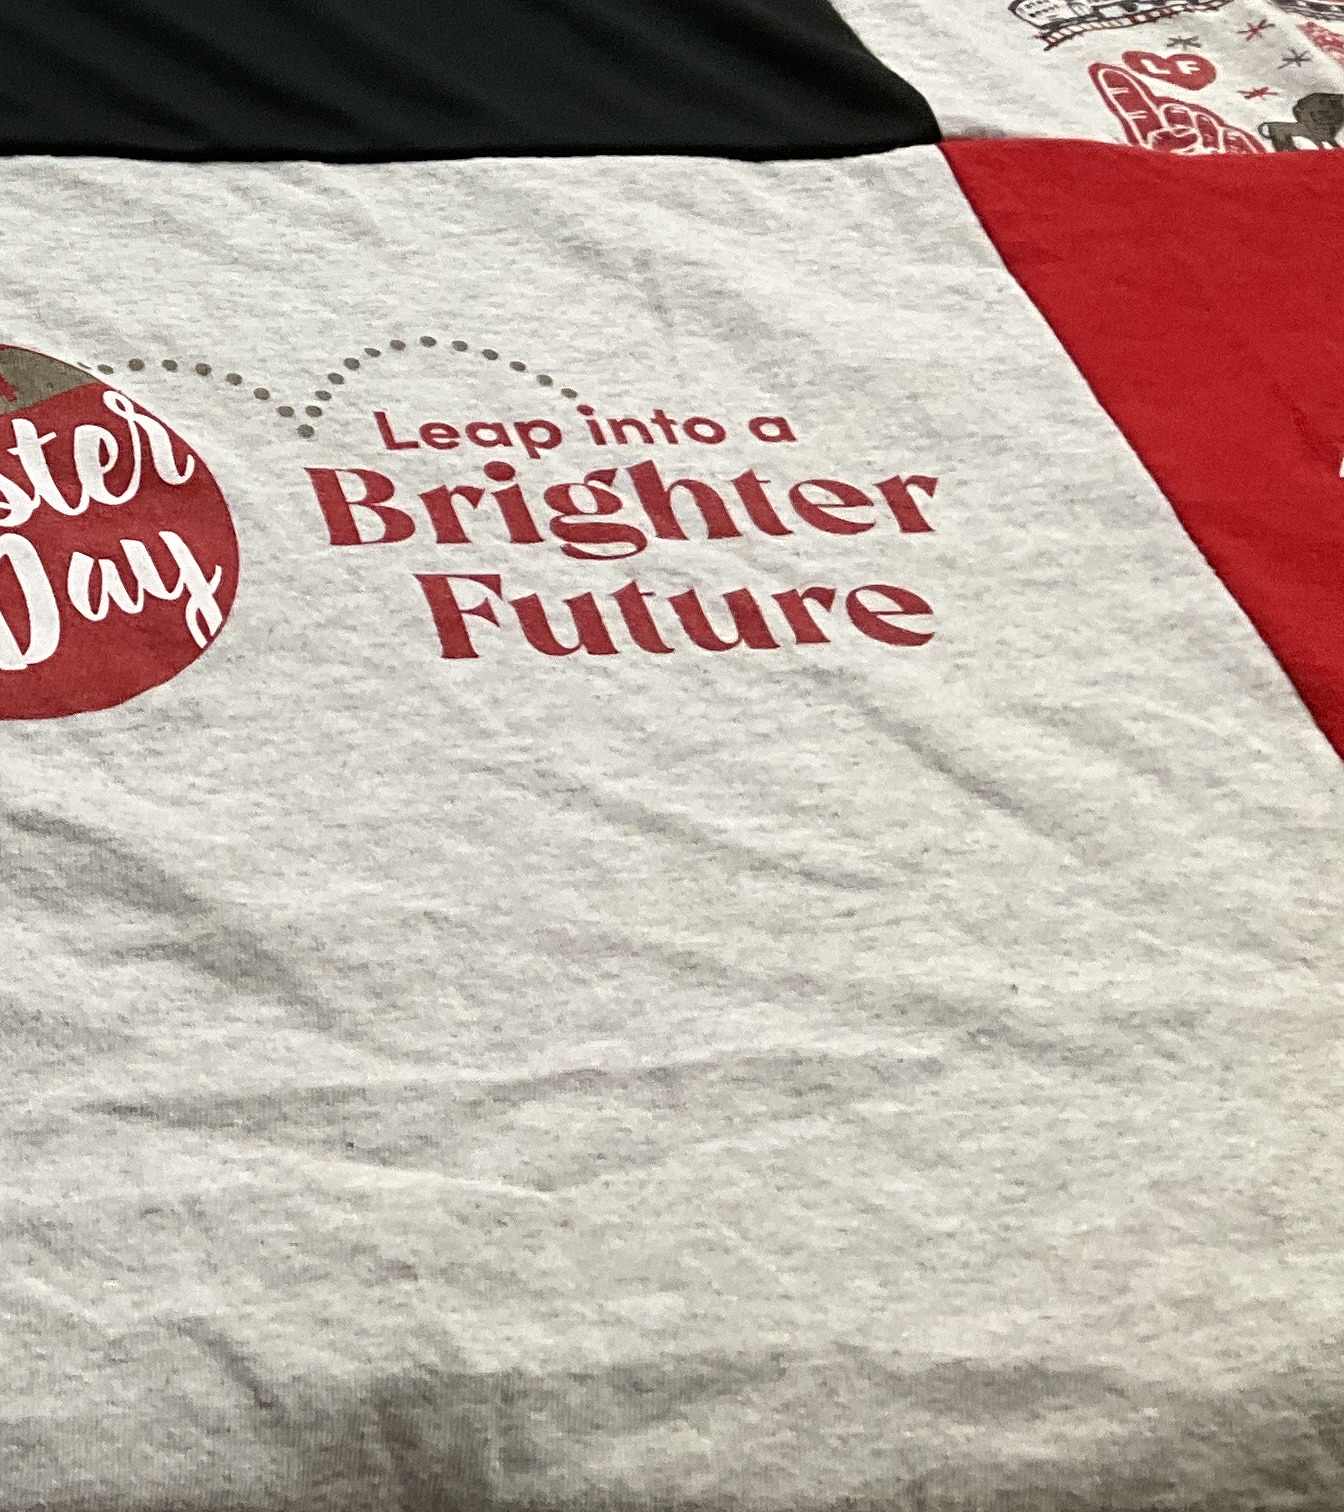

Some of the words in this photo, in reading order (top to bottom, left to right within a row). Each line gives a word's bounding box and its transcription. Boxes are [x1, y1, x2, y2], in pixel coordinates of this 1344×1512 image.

[372, 410, 564, 461] Leap
[576, 403, 728, 447] into
[747, 414, 799, 444] a
[303, 459, 940, 561] Brighter
[412, 573, 937, 661] Future
